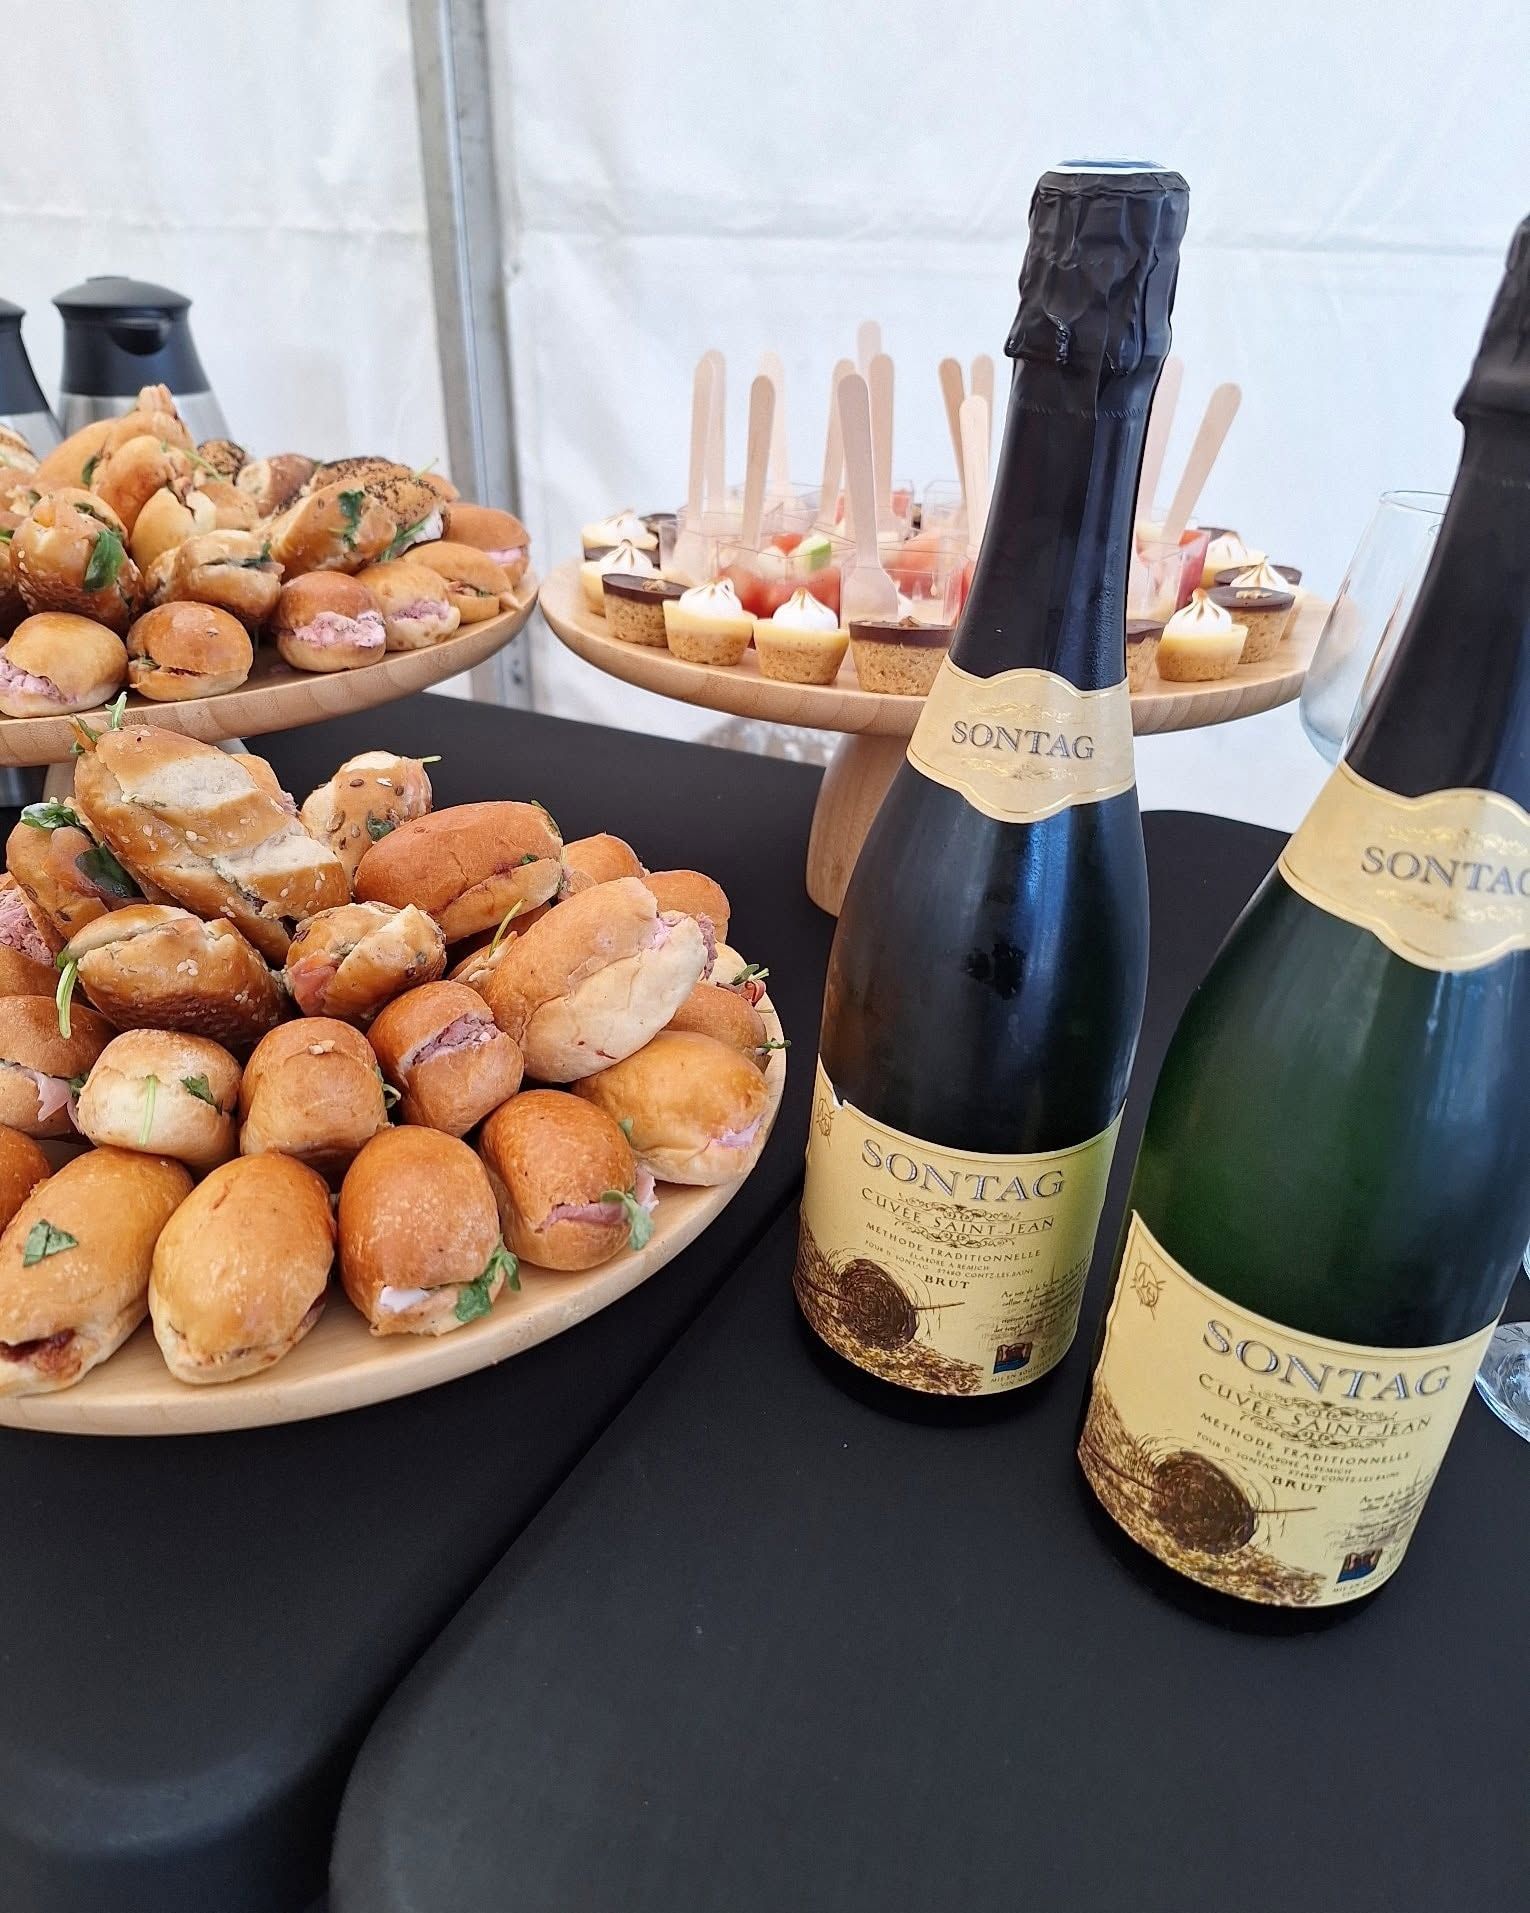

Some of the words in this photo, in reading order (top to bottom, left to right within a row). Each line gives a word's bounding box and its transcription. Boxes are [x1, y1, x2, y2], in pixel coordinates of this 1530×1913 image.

[952, 720, 1094, 759] SONTAG
[861, 1138, 1064, 1201] SONTAG
[933, 1216, 996, 1235] SAINT
[1006, 1217, 1054, 1235] JEAN
[930, 1248, 1041, 1262] TRADITIONNELLE
[924, 1275, 970, 1289] BRUT
[1203, 1319, 1451, 1400] SONTAG
[1291, 1413, 1367, 1436] SAINT
[1376, 1416, 1431, 1437] JEAN
[1283, 1447, 1409, 1466] TRADITIONNELLE
[1272, 1475, 1327, 1493] BRUT
